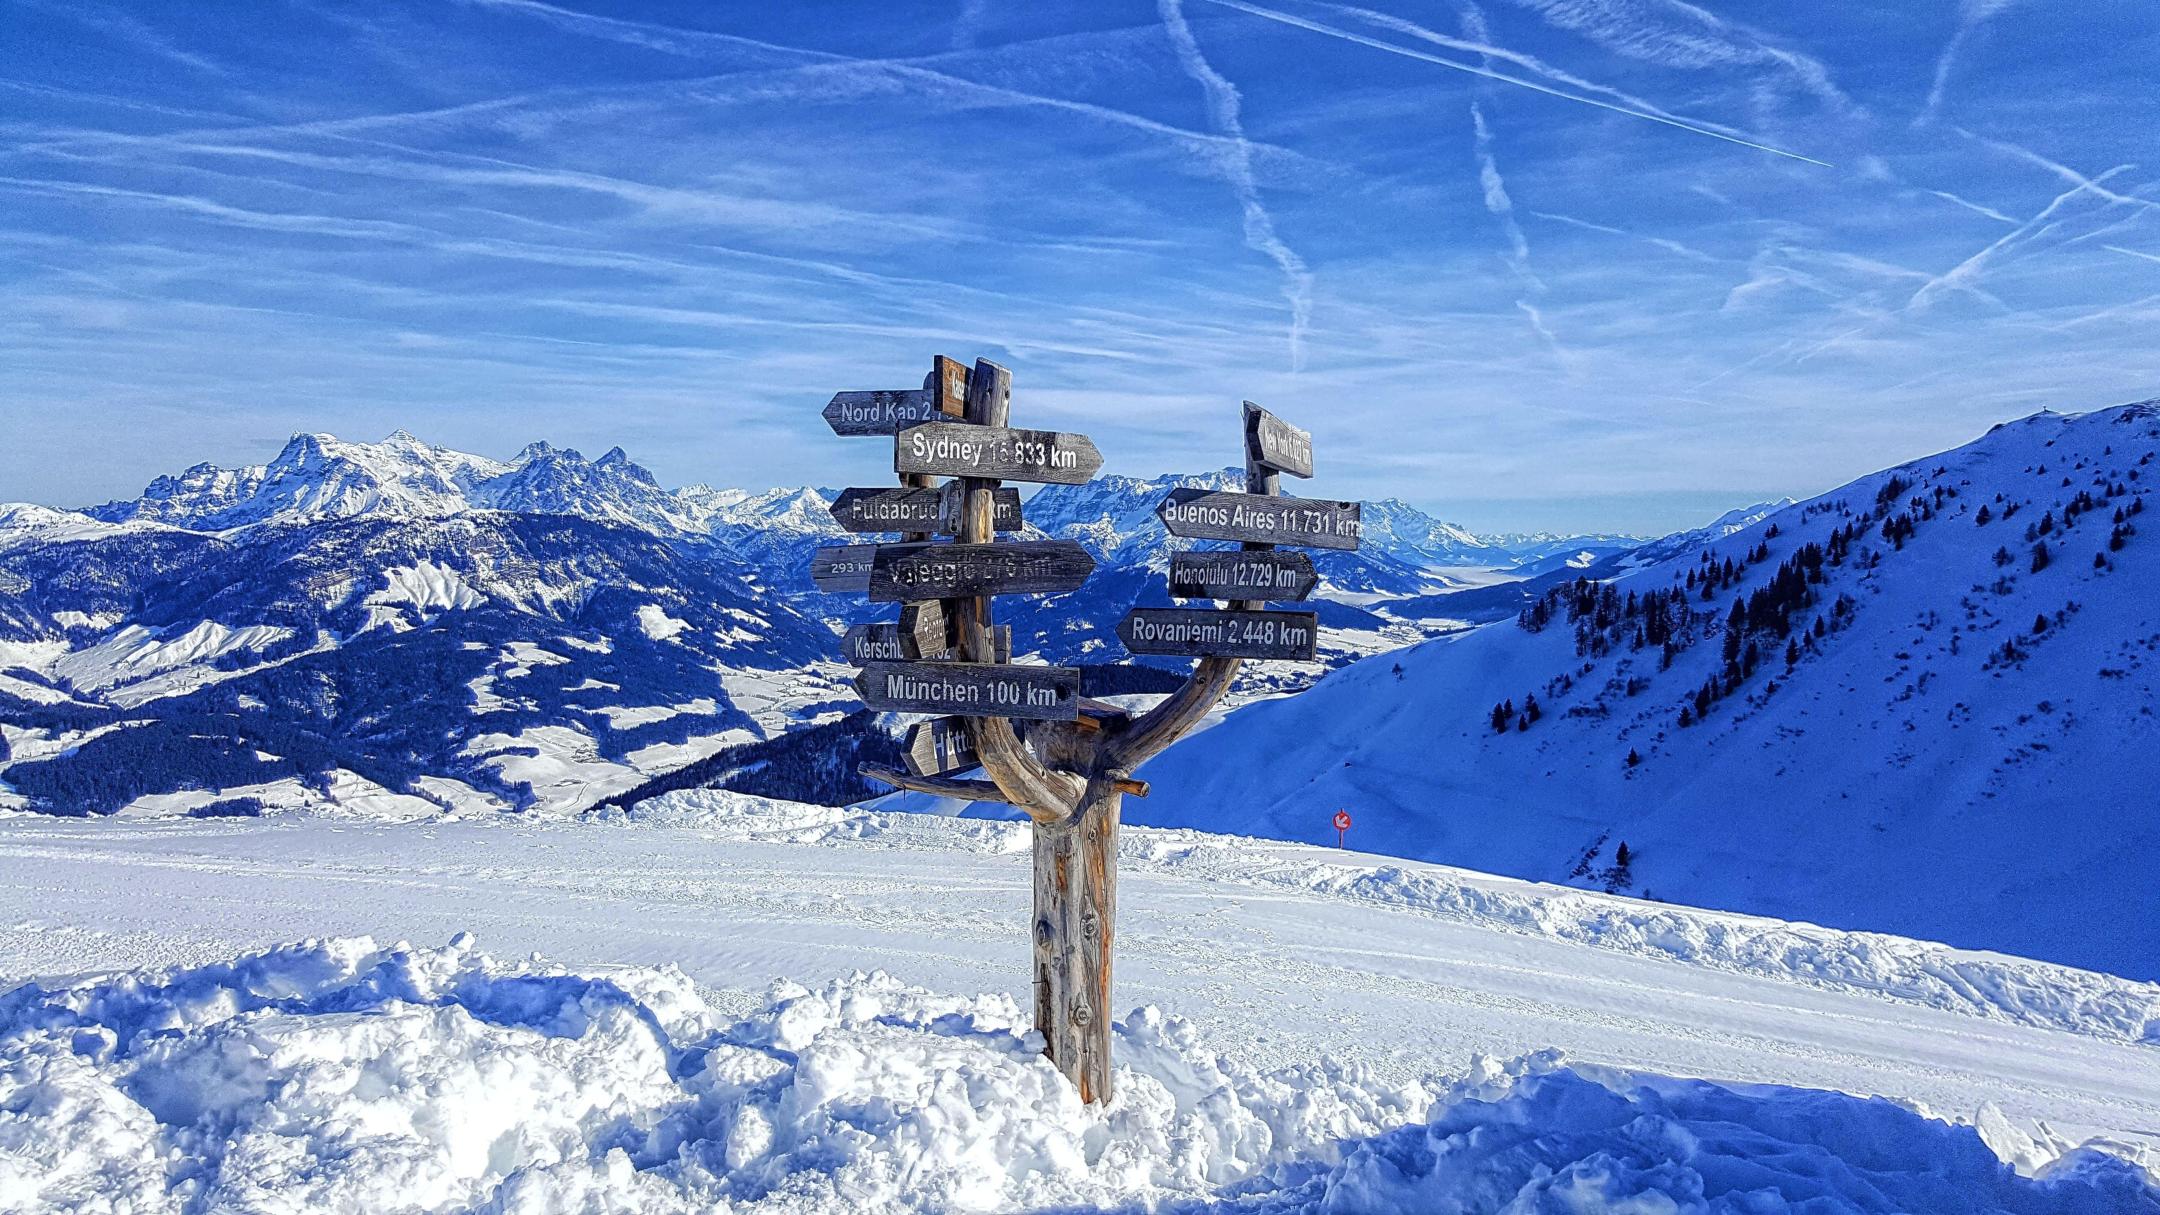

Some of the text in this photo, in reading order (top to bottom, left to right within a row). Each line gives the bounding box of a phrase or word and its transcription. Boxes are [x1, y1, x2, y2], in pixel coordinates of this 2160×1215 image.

[841, 403, 880, 421] Nord
[912, 432, 983, 467] Sydney
[1051, 445, 1077, 468] km
[1277, 430, 1290, 457] York
[852, 499, 938, 520] Fuldabrüc
[1165, 499, 1361, 538] Buenos Aires 11.731 km
[831, 562, 854, 574] 293
[1174, 562, 1296, 588] Honolulu 12.729 km
[1132, 617, 1307, 646] Rovaniemi 2.448 km
[887, 674, 1057, 707] München 100 km
